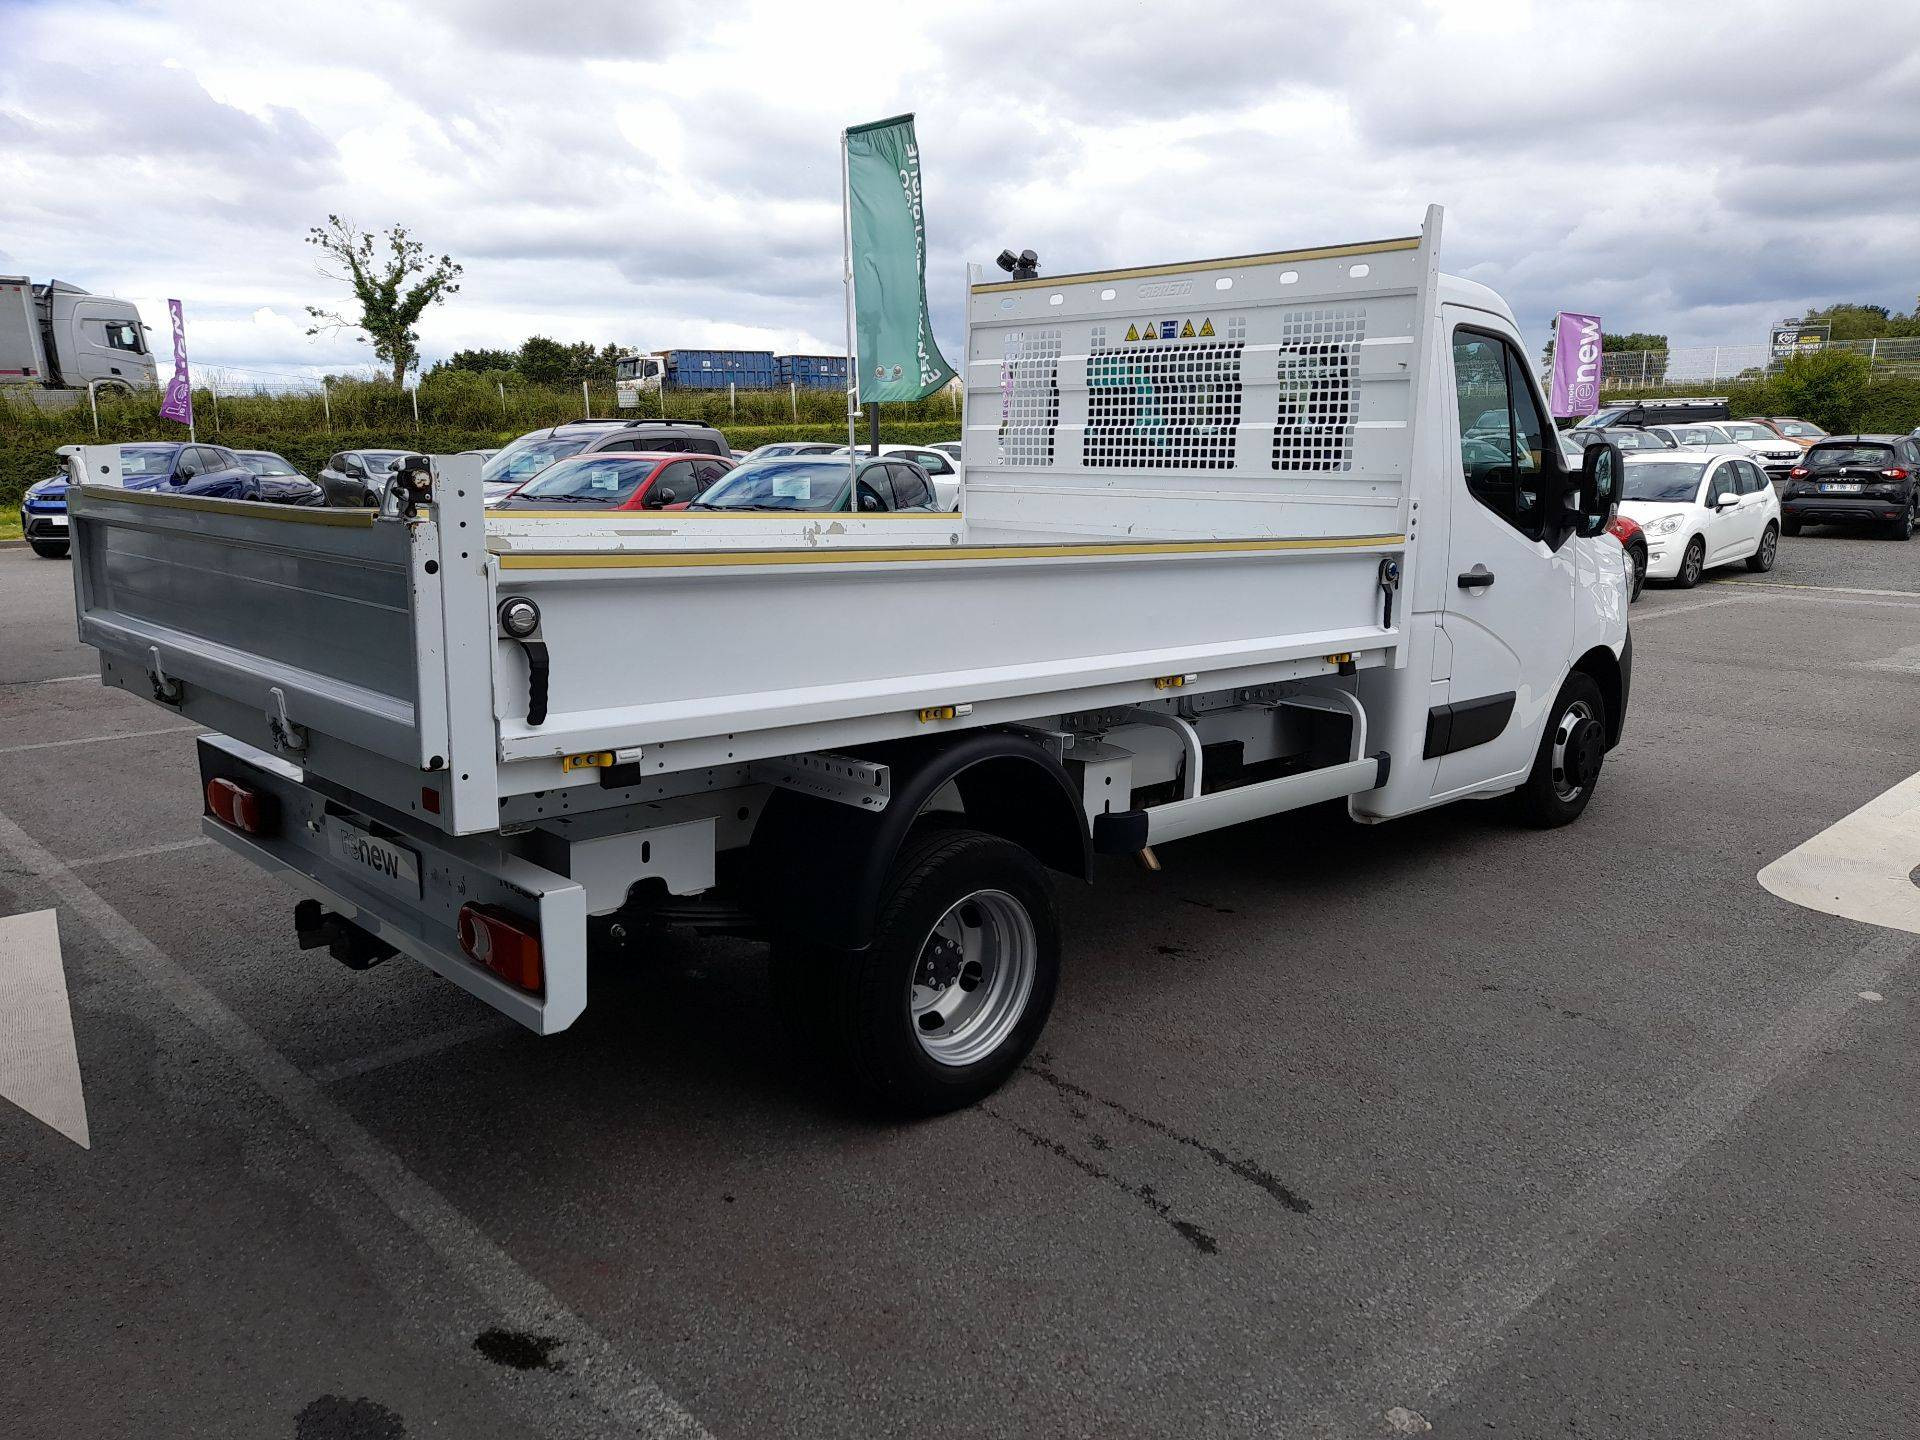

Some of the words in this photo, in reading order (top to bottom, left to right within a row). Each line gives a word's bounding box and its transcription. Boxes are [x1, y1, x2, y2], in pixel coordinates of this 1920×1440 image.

[1575, 317, 1600, 411] renew
[1567, 402, 1574, 413] le
[340, 828, 398, 879] renew
